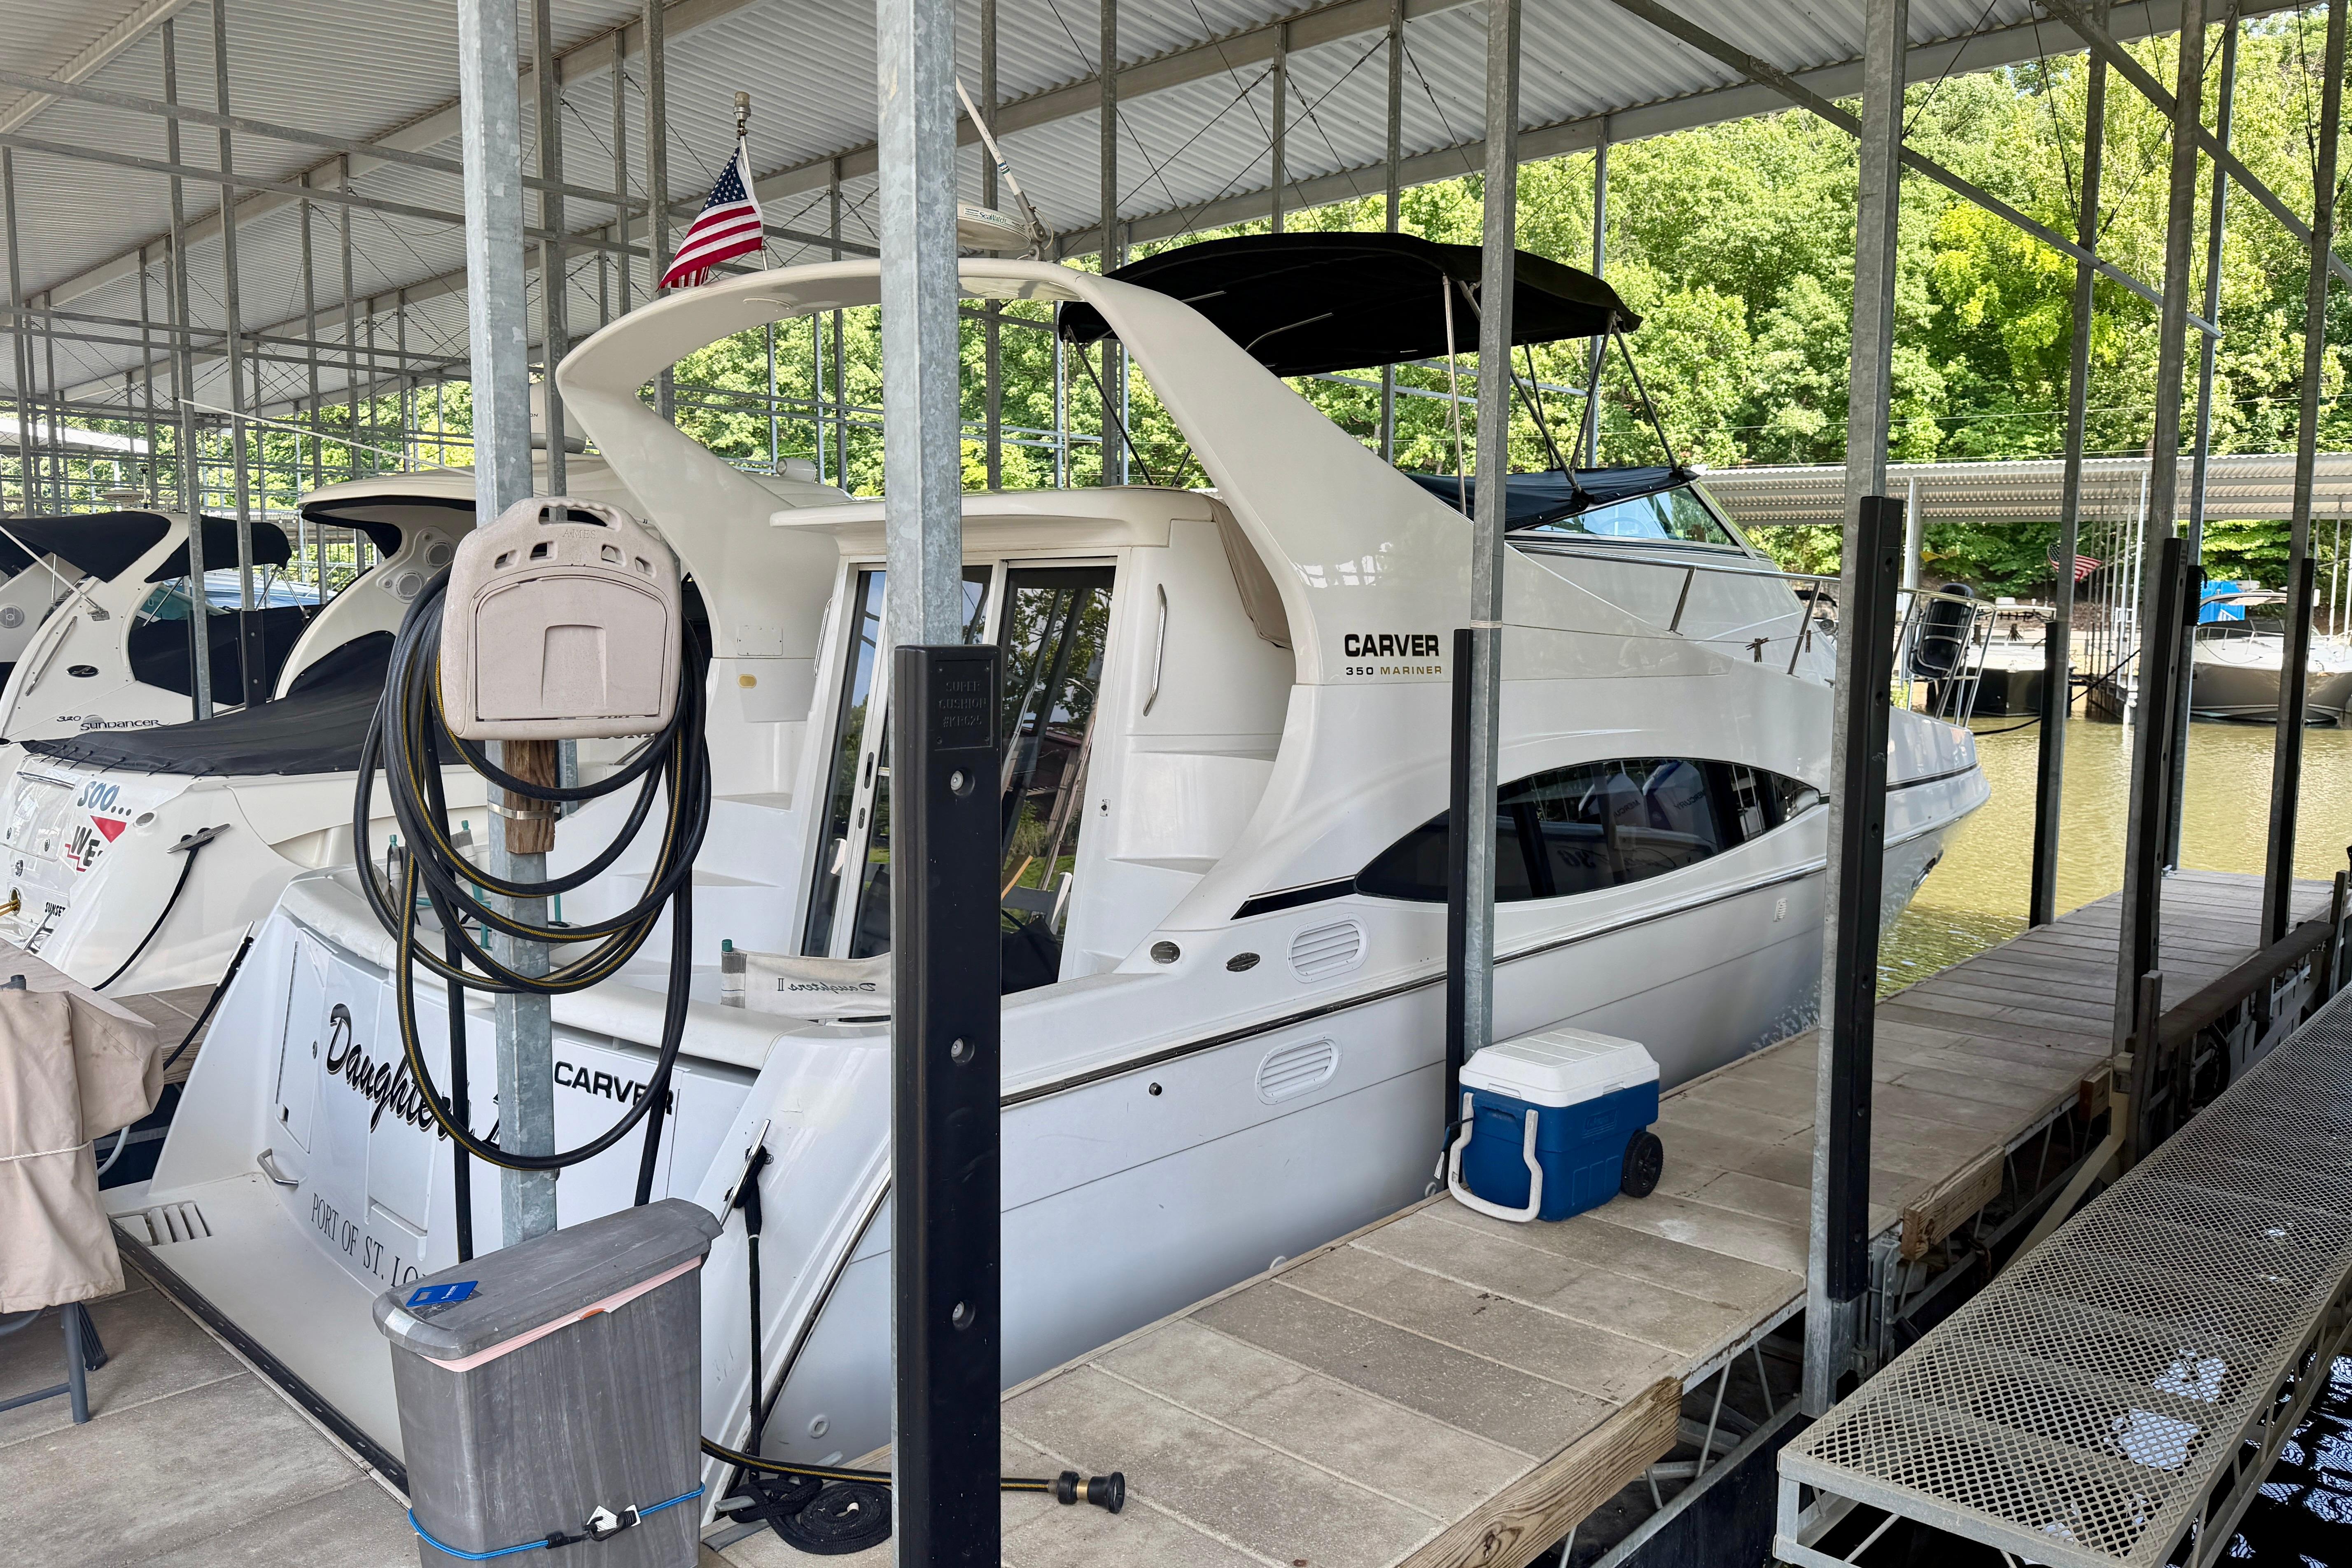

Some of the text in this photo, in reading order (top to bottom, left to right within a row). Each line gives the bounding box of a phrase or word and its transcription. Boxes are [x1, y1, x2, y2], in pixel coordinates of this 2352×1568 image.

[562, 528, 597, 539] AMES
[1344, 633, 1440, 657] CARVER
[1346, 665, 1442, 676] 350 MARINER
[945, 680, 982, 693] SUPER
[938, 698, 987, 710] CUSHION
[311, 1192, 339, 1242] PORT
[342, 1220, 359, 1256] OF
[363, 1236, 384, 1280] ST.
